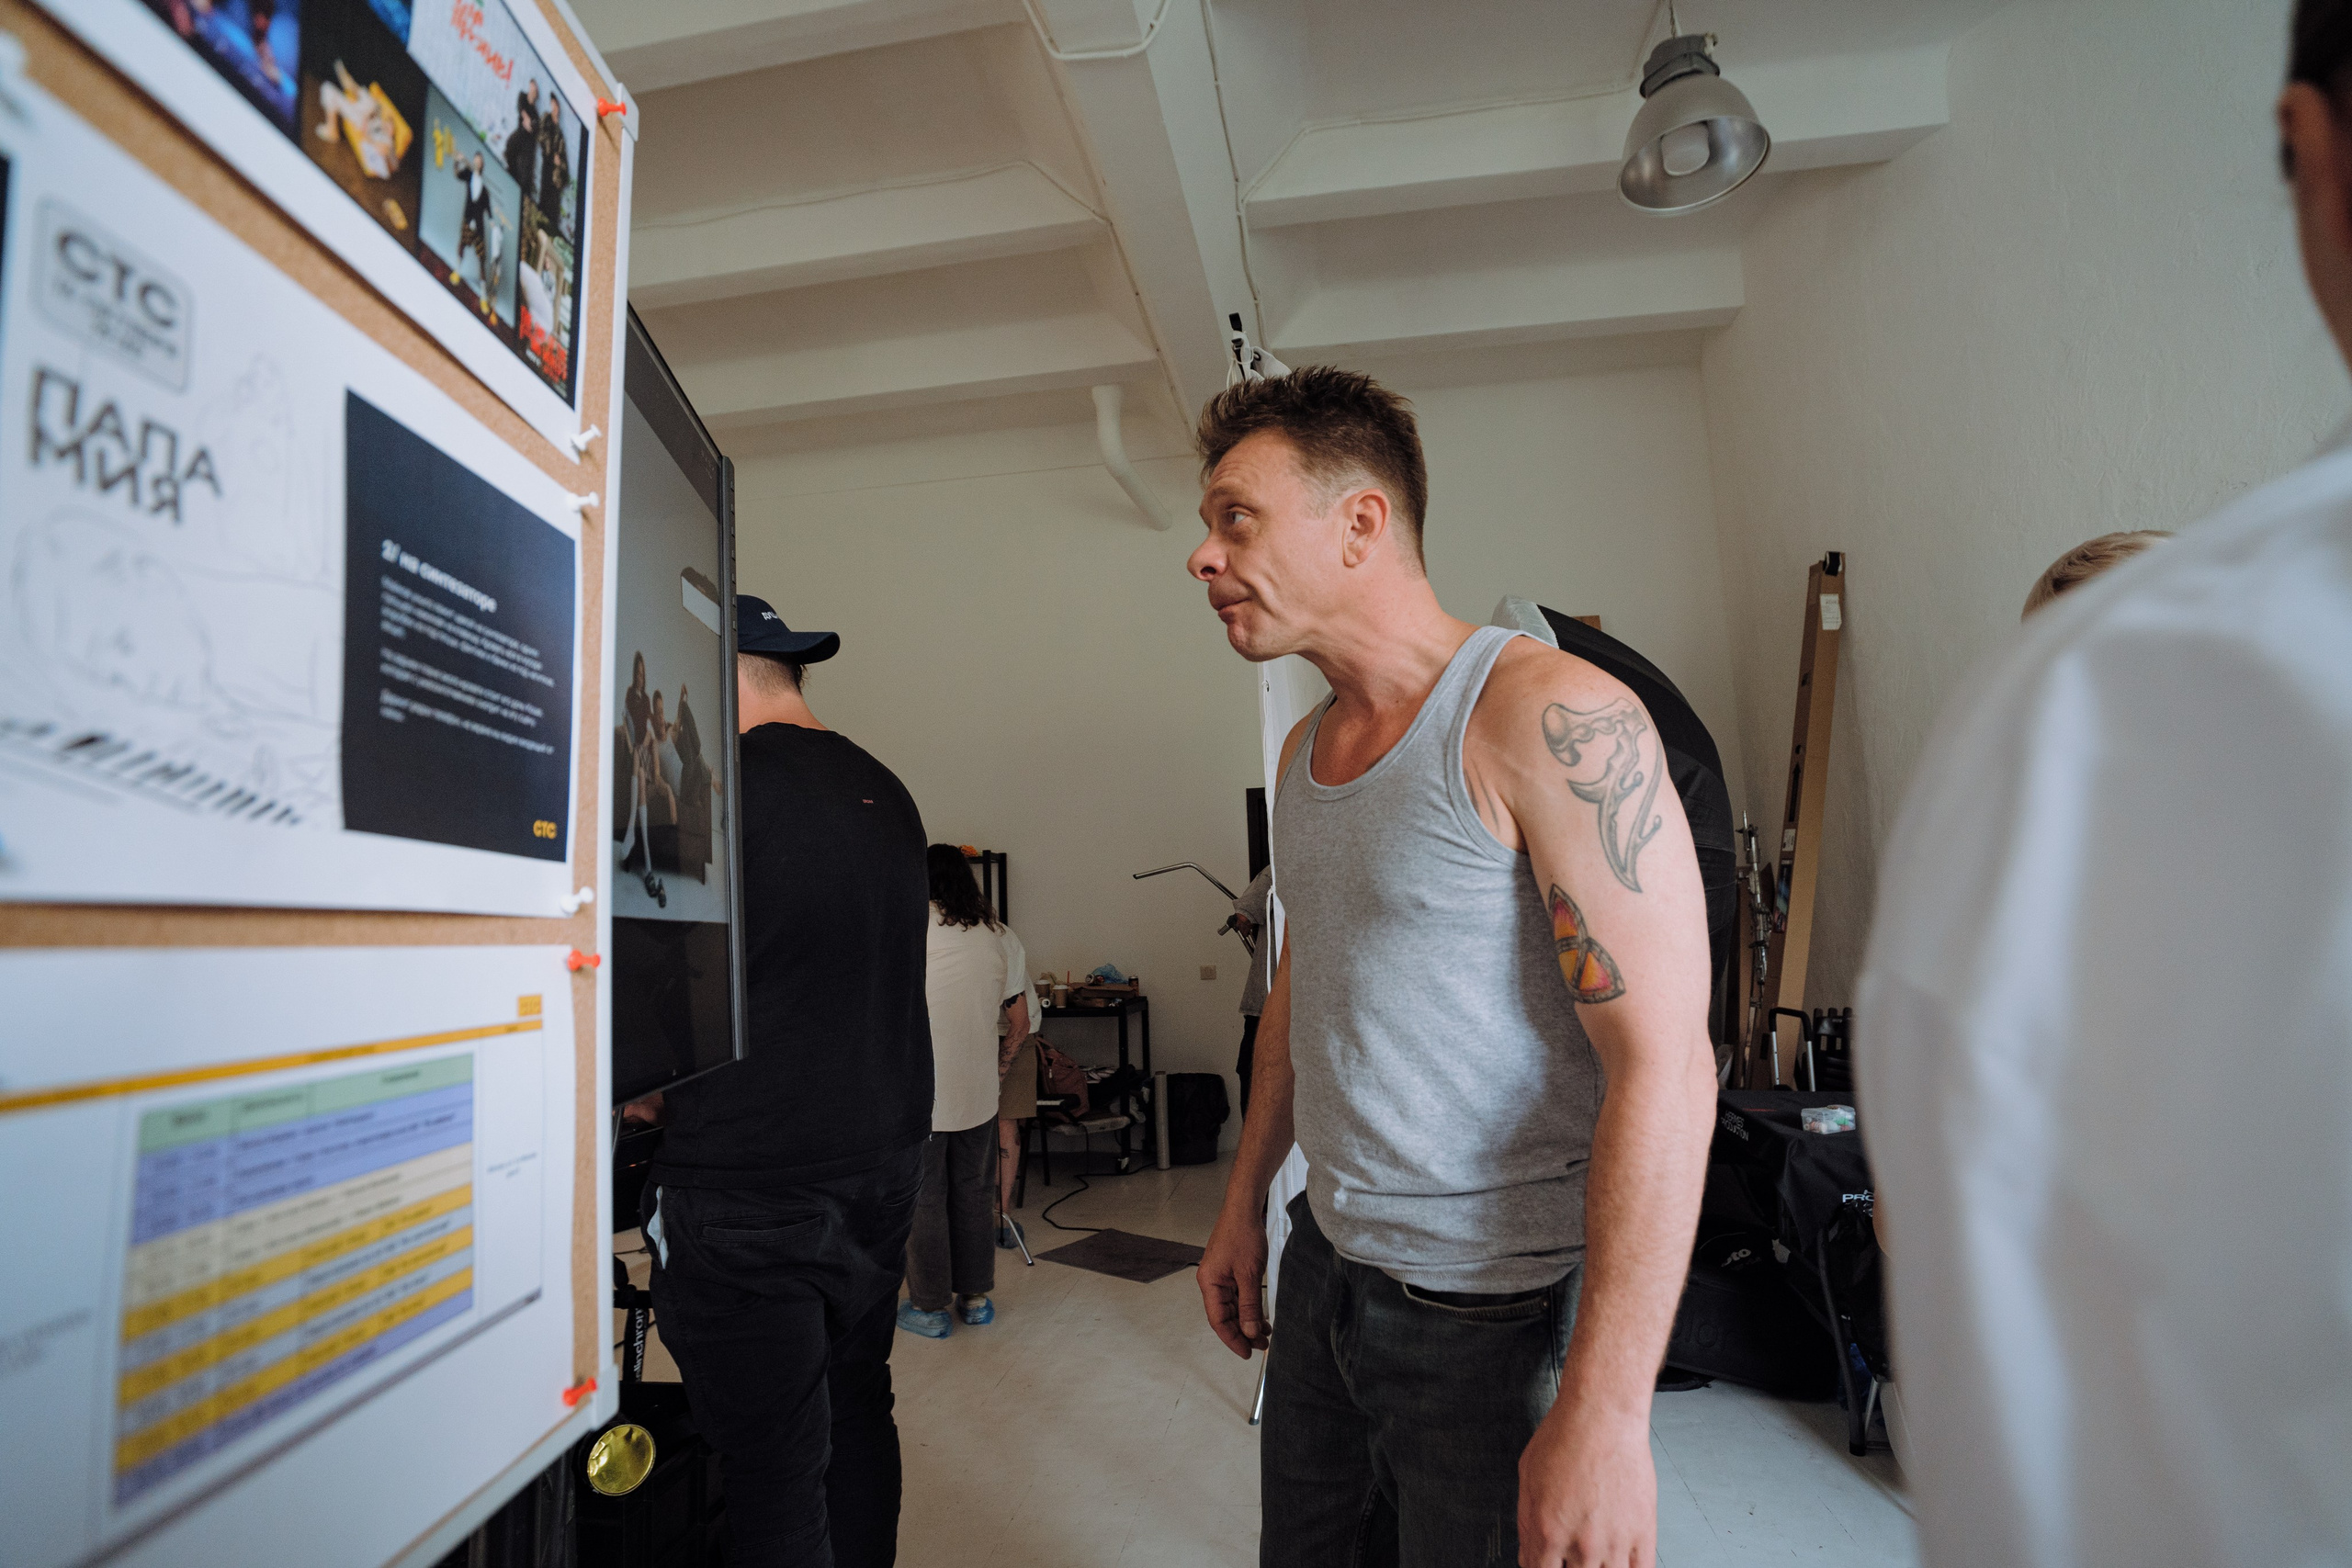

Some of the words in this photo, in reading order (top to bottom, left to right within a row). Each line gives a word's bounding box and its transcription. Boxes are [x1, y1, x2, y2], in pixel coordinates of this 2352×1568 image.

[55, 229, 178, 329] СТС
[30, 421, 182, 525] МИЯ
[32, 363, 222, 501] ПАПА
[534, 819, 558, 840] СТС
